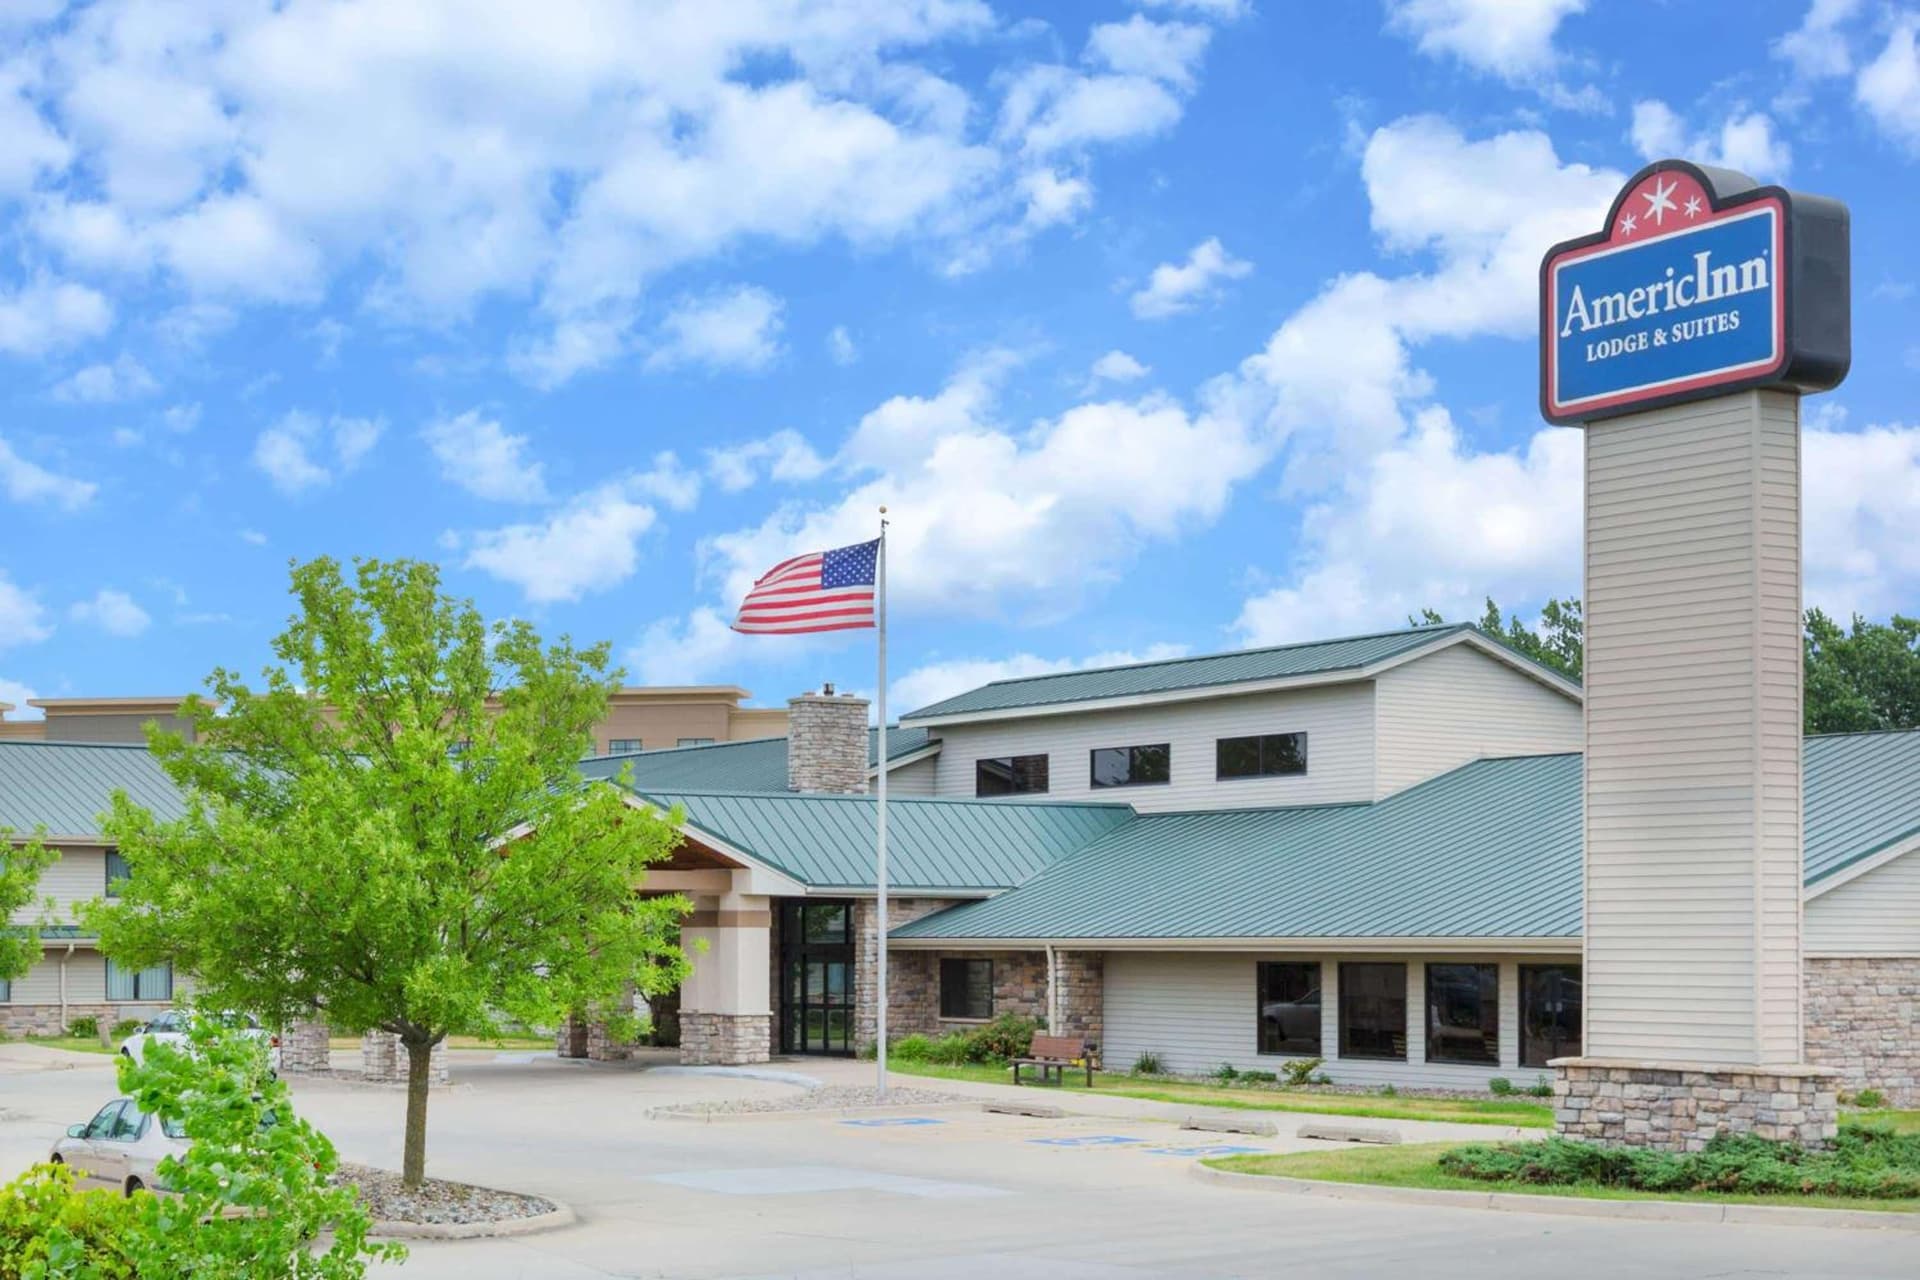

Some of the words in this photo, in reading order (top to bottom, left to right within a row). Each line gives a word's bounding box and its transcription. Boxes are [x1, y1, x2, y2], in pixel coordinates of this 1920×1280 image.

[1560, 250, 1769, 338] AmericInn
[1586, 332, 1649, 362] LODGE
[1653, 328, 1668, 347] &
[1672, 310, 1740, 343] SUITES
